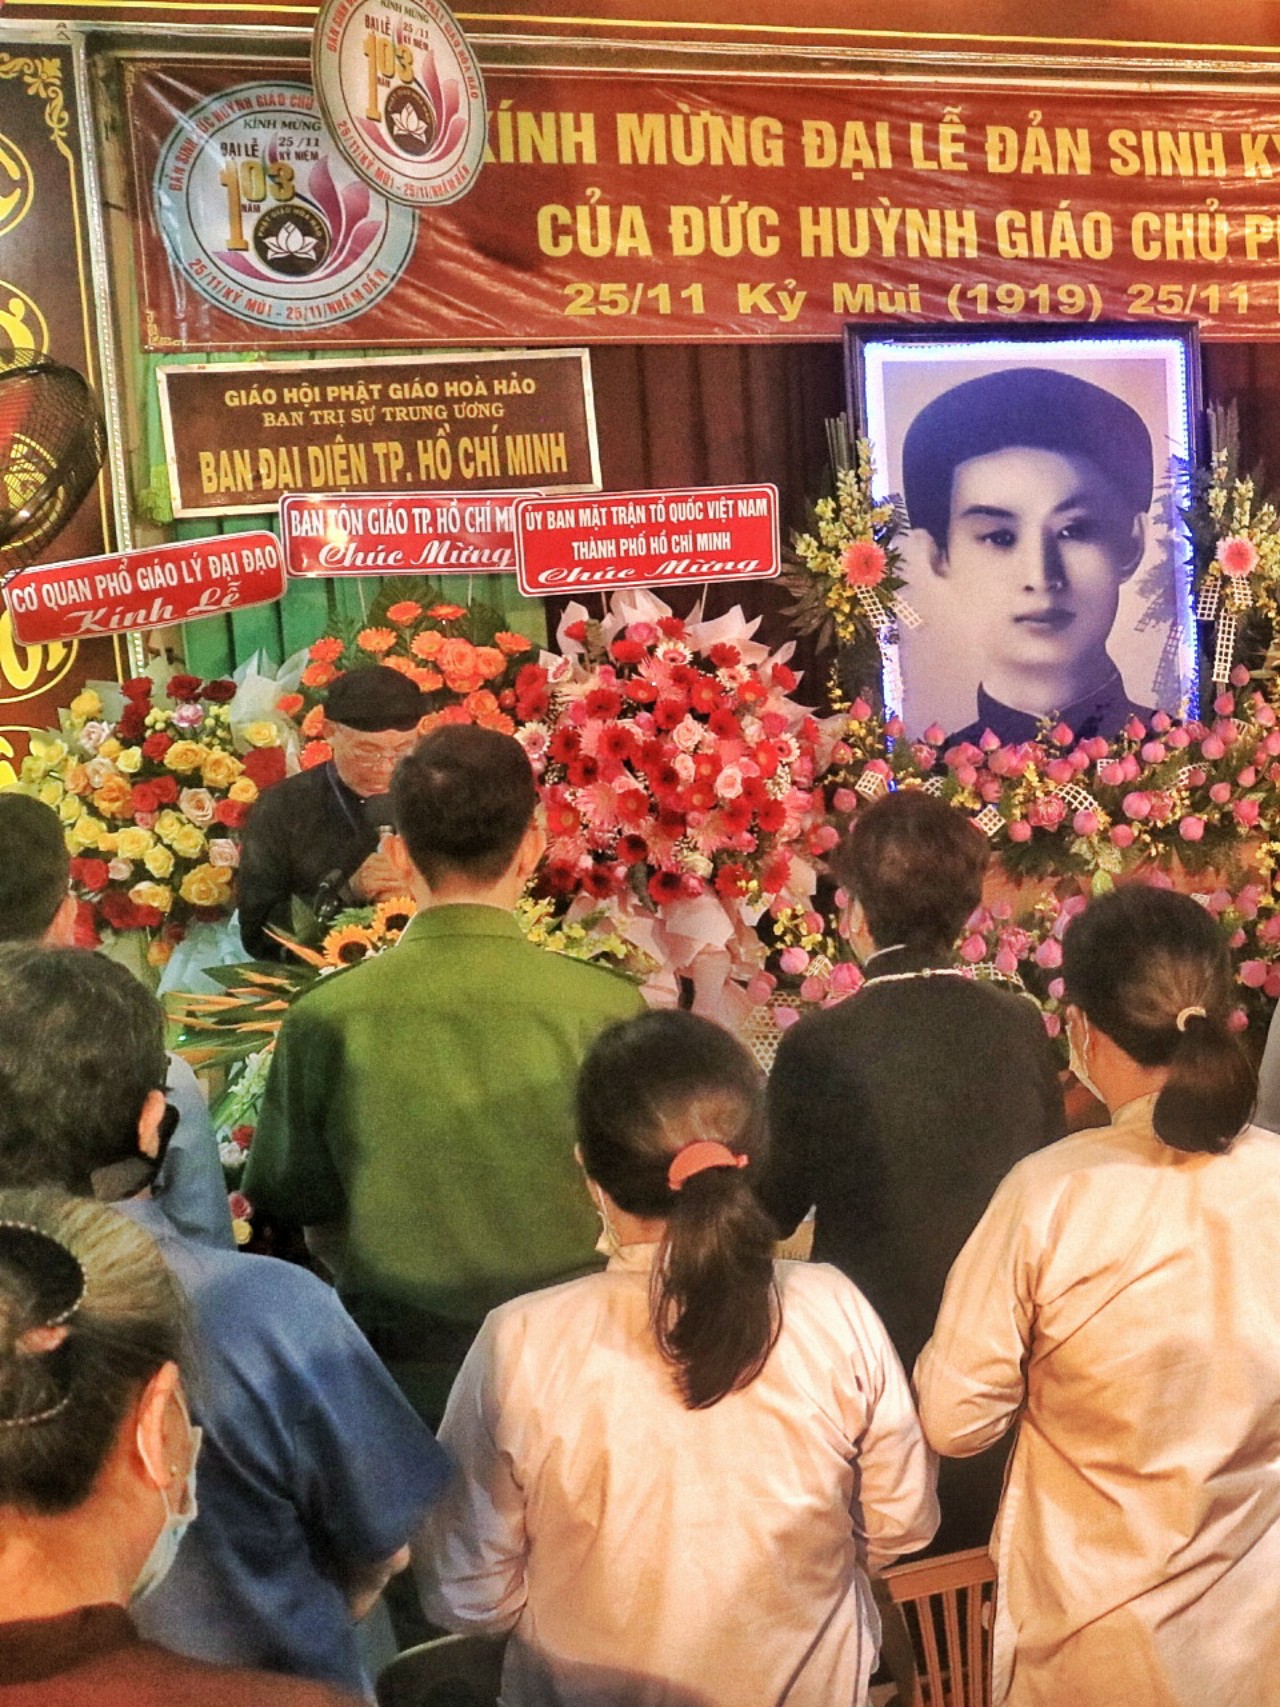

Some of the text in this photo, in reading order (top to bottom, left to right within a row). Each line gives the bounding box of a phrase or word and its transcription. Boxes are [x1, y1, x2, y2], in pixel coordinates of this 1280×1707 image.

[362, 33, 414, 122] 103
[175, 137, 198, 165] SINH
[256, 90, 286, 107] GIÁO
[243, 117, 322, 132] KÍNH MỪNG
[279, 136, 294, 147] 25
[616, 102, 785, 168] MỪNG
[801, 119, 893, 180] ĐẠI
[910, 106, 968, 171] LỄ
[984, 110, 1091, 176] ĐẢN
[1108, 128, 1226, 178] SINH
[244, 137, 259, 157] LỄ
[219, 159, 296, 251] 103
[537, 187, 653, 258] CỦA
[669, 195, 780, 257] ĐỨC
[800, 197, 978, 259] HUỲNH
[995, 200, 1113, 260] GIÁO
[1131, 197, 1228, 261] CHỦ
[563, 282, 705, 315] 25/11
[737, 278, 806, 322] Kỷ
[832, 283, 921, 314] Mùi
[948, 283, 1103, 321] (1919)
[1127, 284, 1249, 315] 25/11
[224, 371, 536, 406] GIÁO HỘI PHẬT GIÁO HOÀ HẢO
[263, 402, 505, 428] BAN TRỊ SỰ TRUNG ƯƠNG
[200, 424, 568, 494] BAN ĐẠI DIỆN TP. HỒ CHÍ MINH
[291, 499, 491, 537] BAN TÔN GIÁO TP. HỒ CHÍ
[525, 496, 768, 531] ỦY BAN MẶT TRẬN TỔ QUỐC VIỆT NAM
[318, 539, 515, 568] Chúc Mừng
[571, 529, 731, 561] THÀNH PHỐ HỒ CHÍ MINH
[12, 545, 278, 613] CƠ QUAN PHỔ GIÁO LÝ ĐẠI ĐẠO
[537, 558, 762, 585] Chúc Mừng
[61, 580, 242, 636] Kính Lễ
